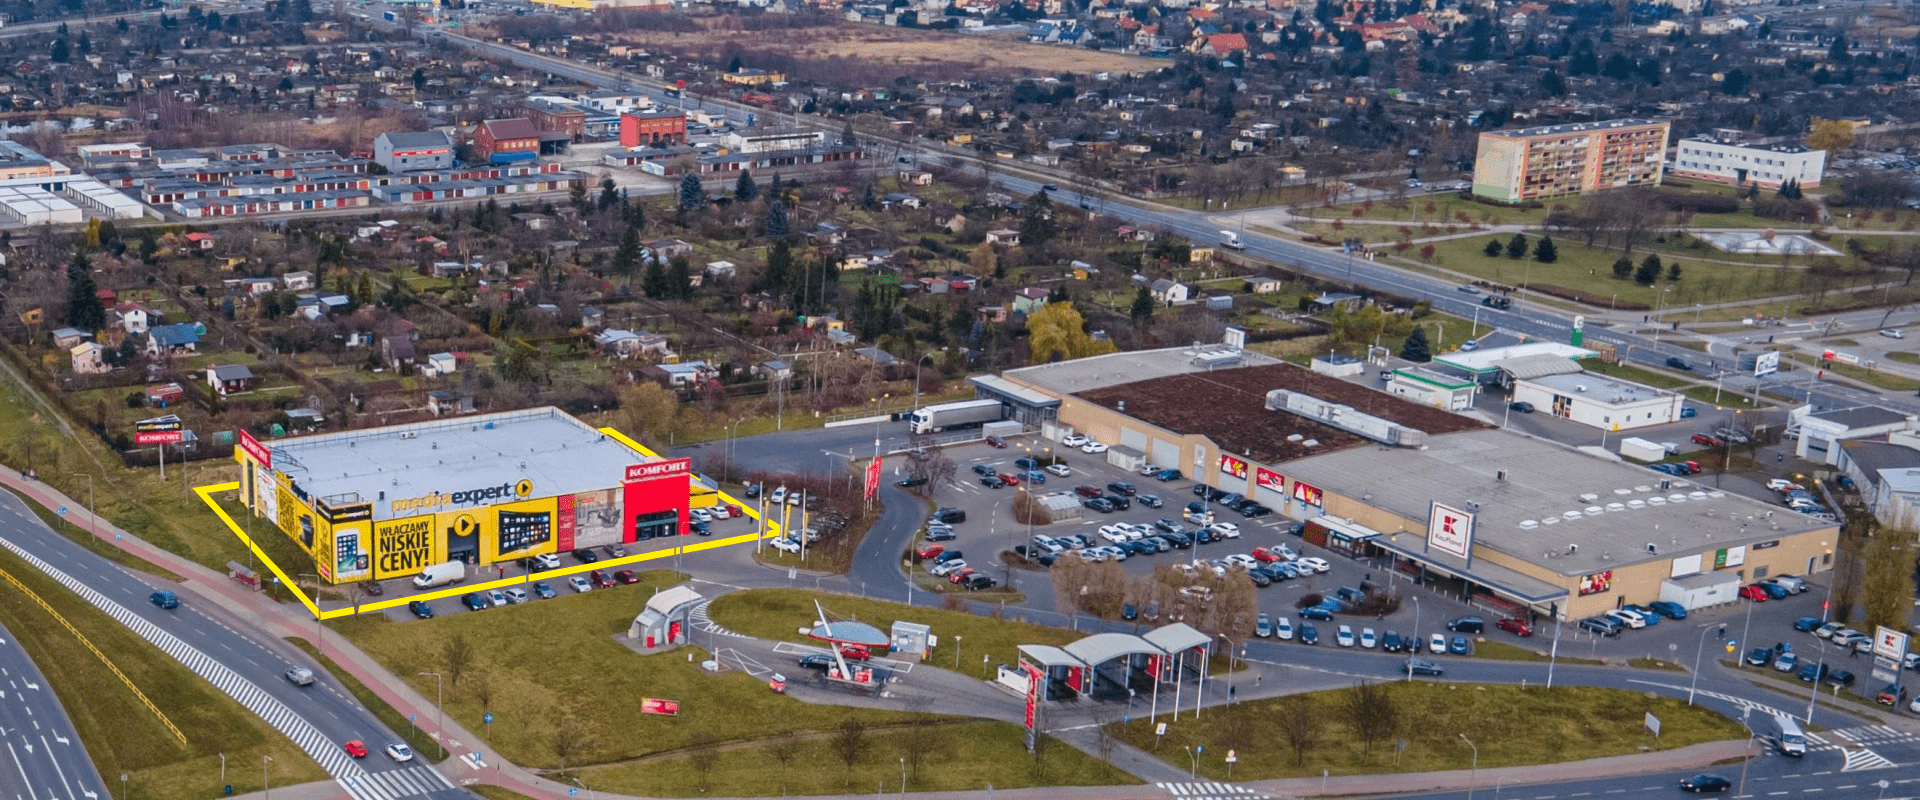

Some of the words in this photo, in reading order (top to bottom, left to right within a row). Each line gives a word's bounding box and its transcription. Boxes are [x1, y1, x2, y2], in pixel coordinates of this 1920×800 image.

[629, 461, 686, 477] KOMFORT
[391, 482, 511, 512] mediaexpert
[380, 531, 429, 552] NISKIE
[379, 548, 429, 572] CENY!
